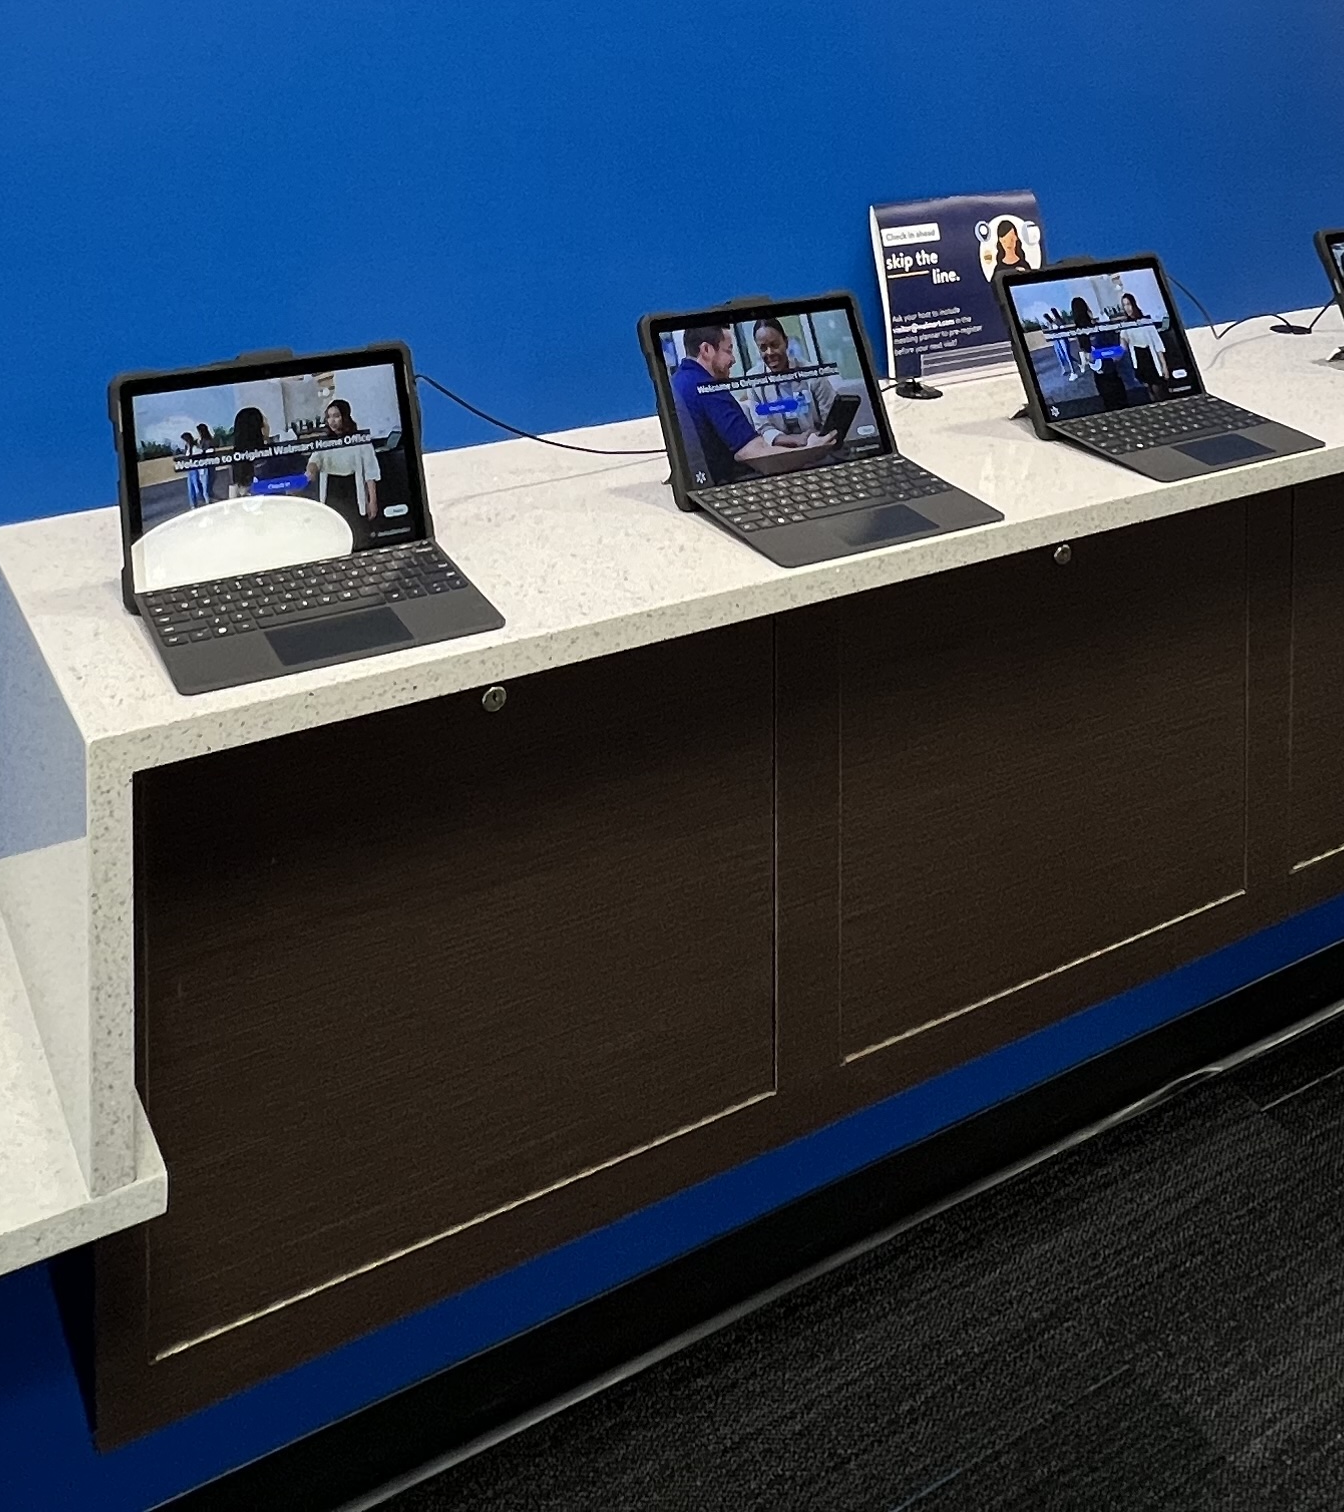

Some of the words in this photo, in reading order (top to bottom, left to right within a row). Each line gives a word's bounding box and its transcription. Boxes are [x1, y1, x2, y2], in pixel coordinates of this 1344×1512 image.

[886, 252, 913, 272] skip
[915, 249, 938, 266] the
[932, 268, 960, 284] line.
[174, 456, 220, 471] Welcome
[222, 453, 232, 463] to
[234, 445, 272, 462] Original
[273, 440, 315, 457] Walmart
[316, 438, 343, 450] Home
[344, 433, 372, 445] Office
